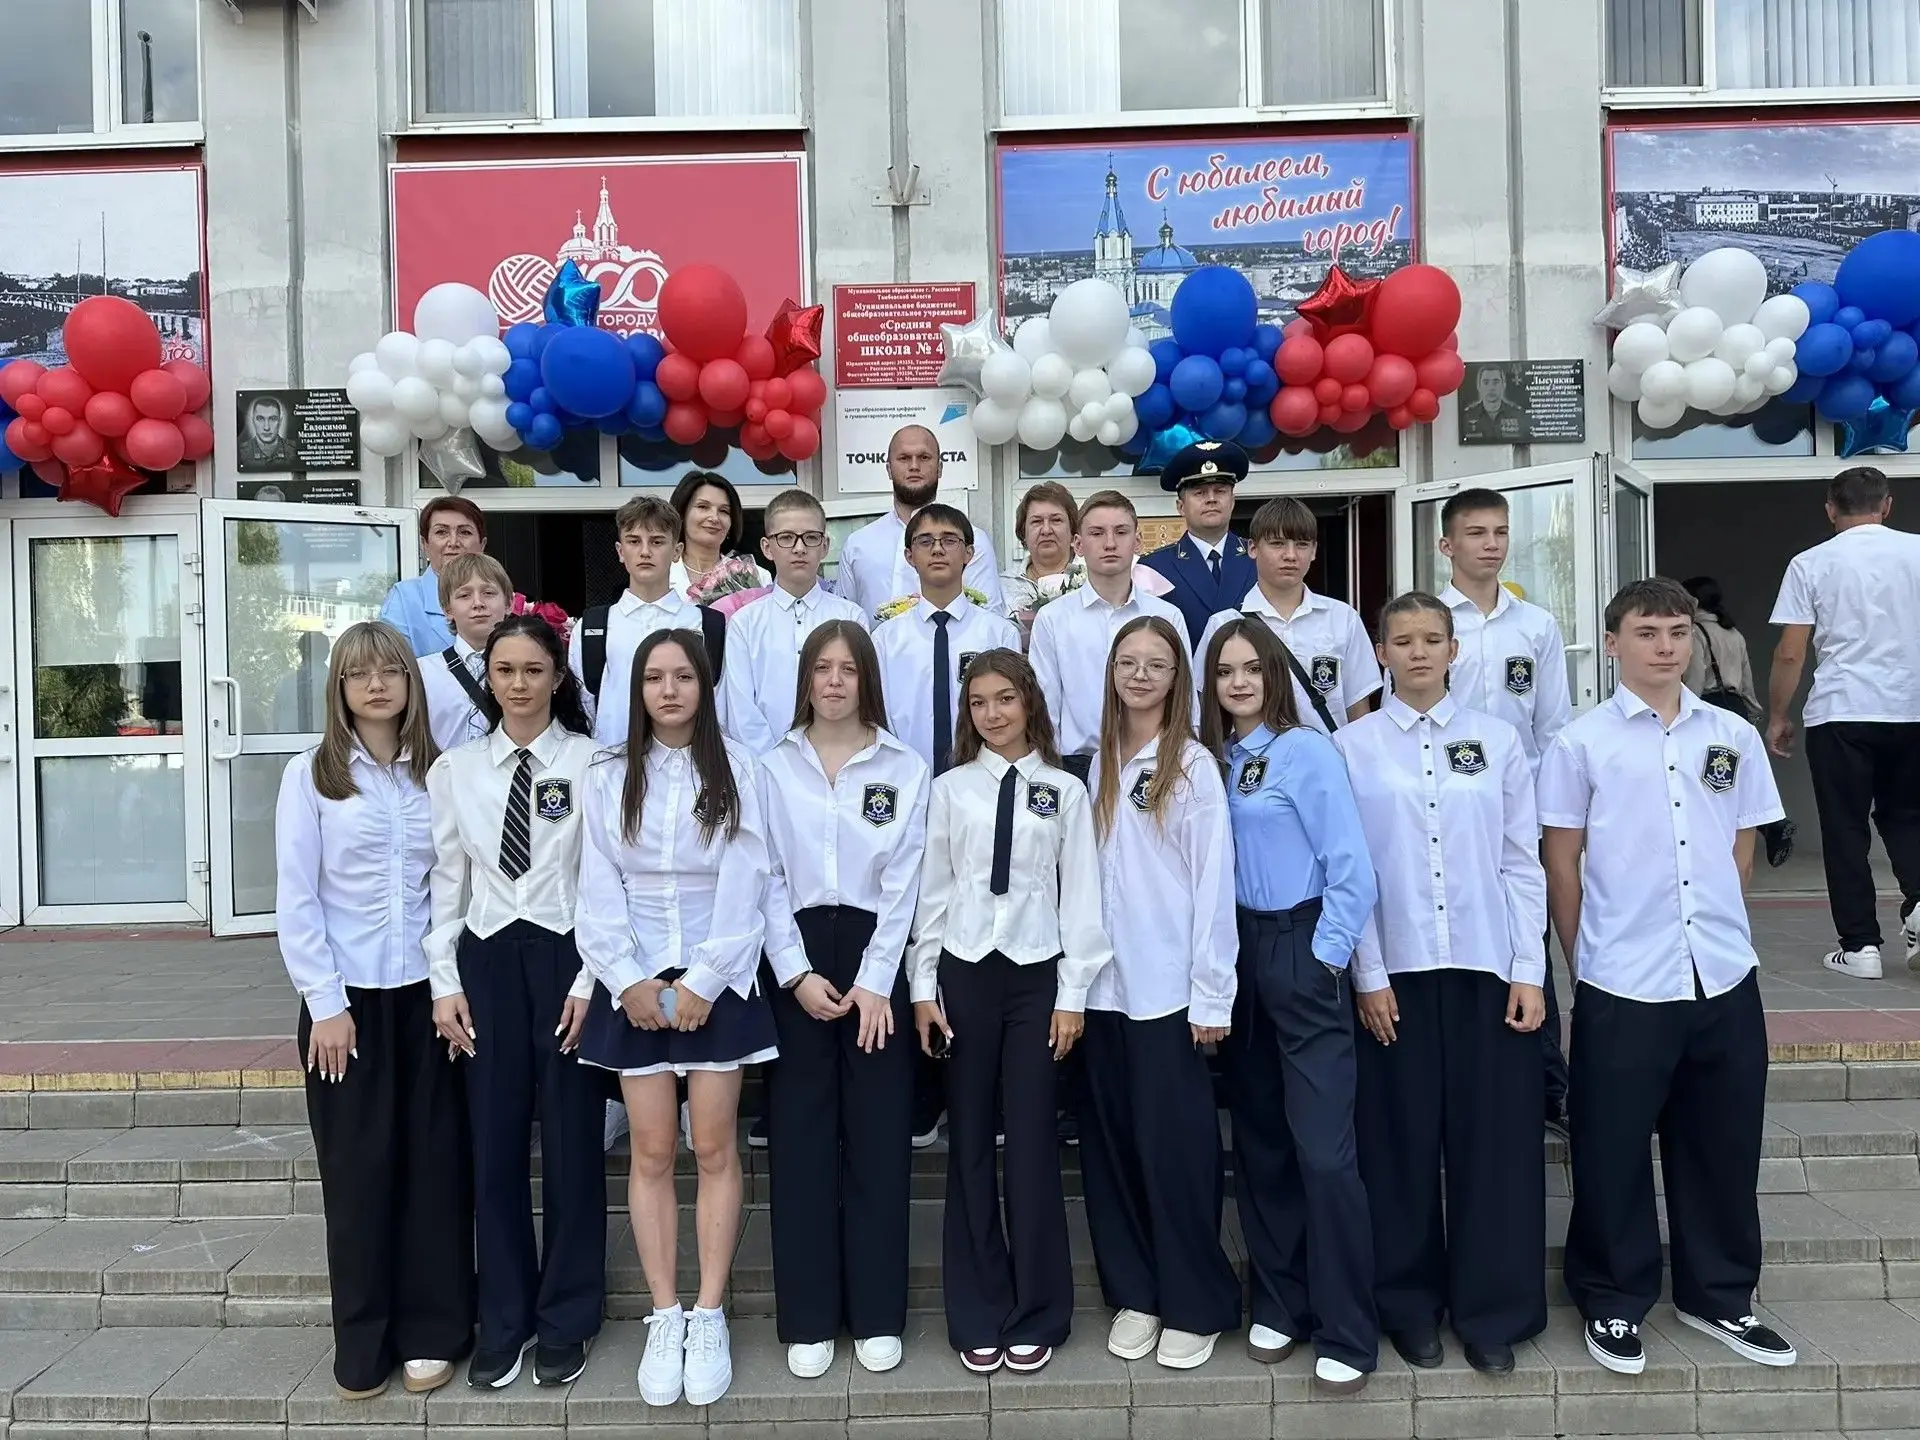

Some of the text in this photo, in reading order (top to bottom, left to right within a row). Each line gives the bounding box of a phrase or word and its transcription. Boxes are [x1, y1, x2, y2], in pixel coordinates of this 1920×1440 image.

[1147, 153, 1330, 201] С юбилеем,
[1212, 177, 1366, 230] любимый
[1303, 205, 1401, 260] город!
[854, 301, 957, 311] Муниципальное бюджетное
[842, 309, 967, 319] общеобразовательное учреждение
[879, 319, 932, 332] «Средняя
[860, 341, 944, 356] школа № 4
[846, 452, 888, 464] ТОЧК
